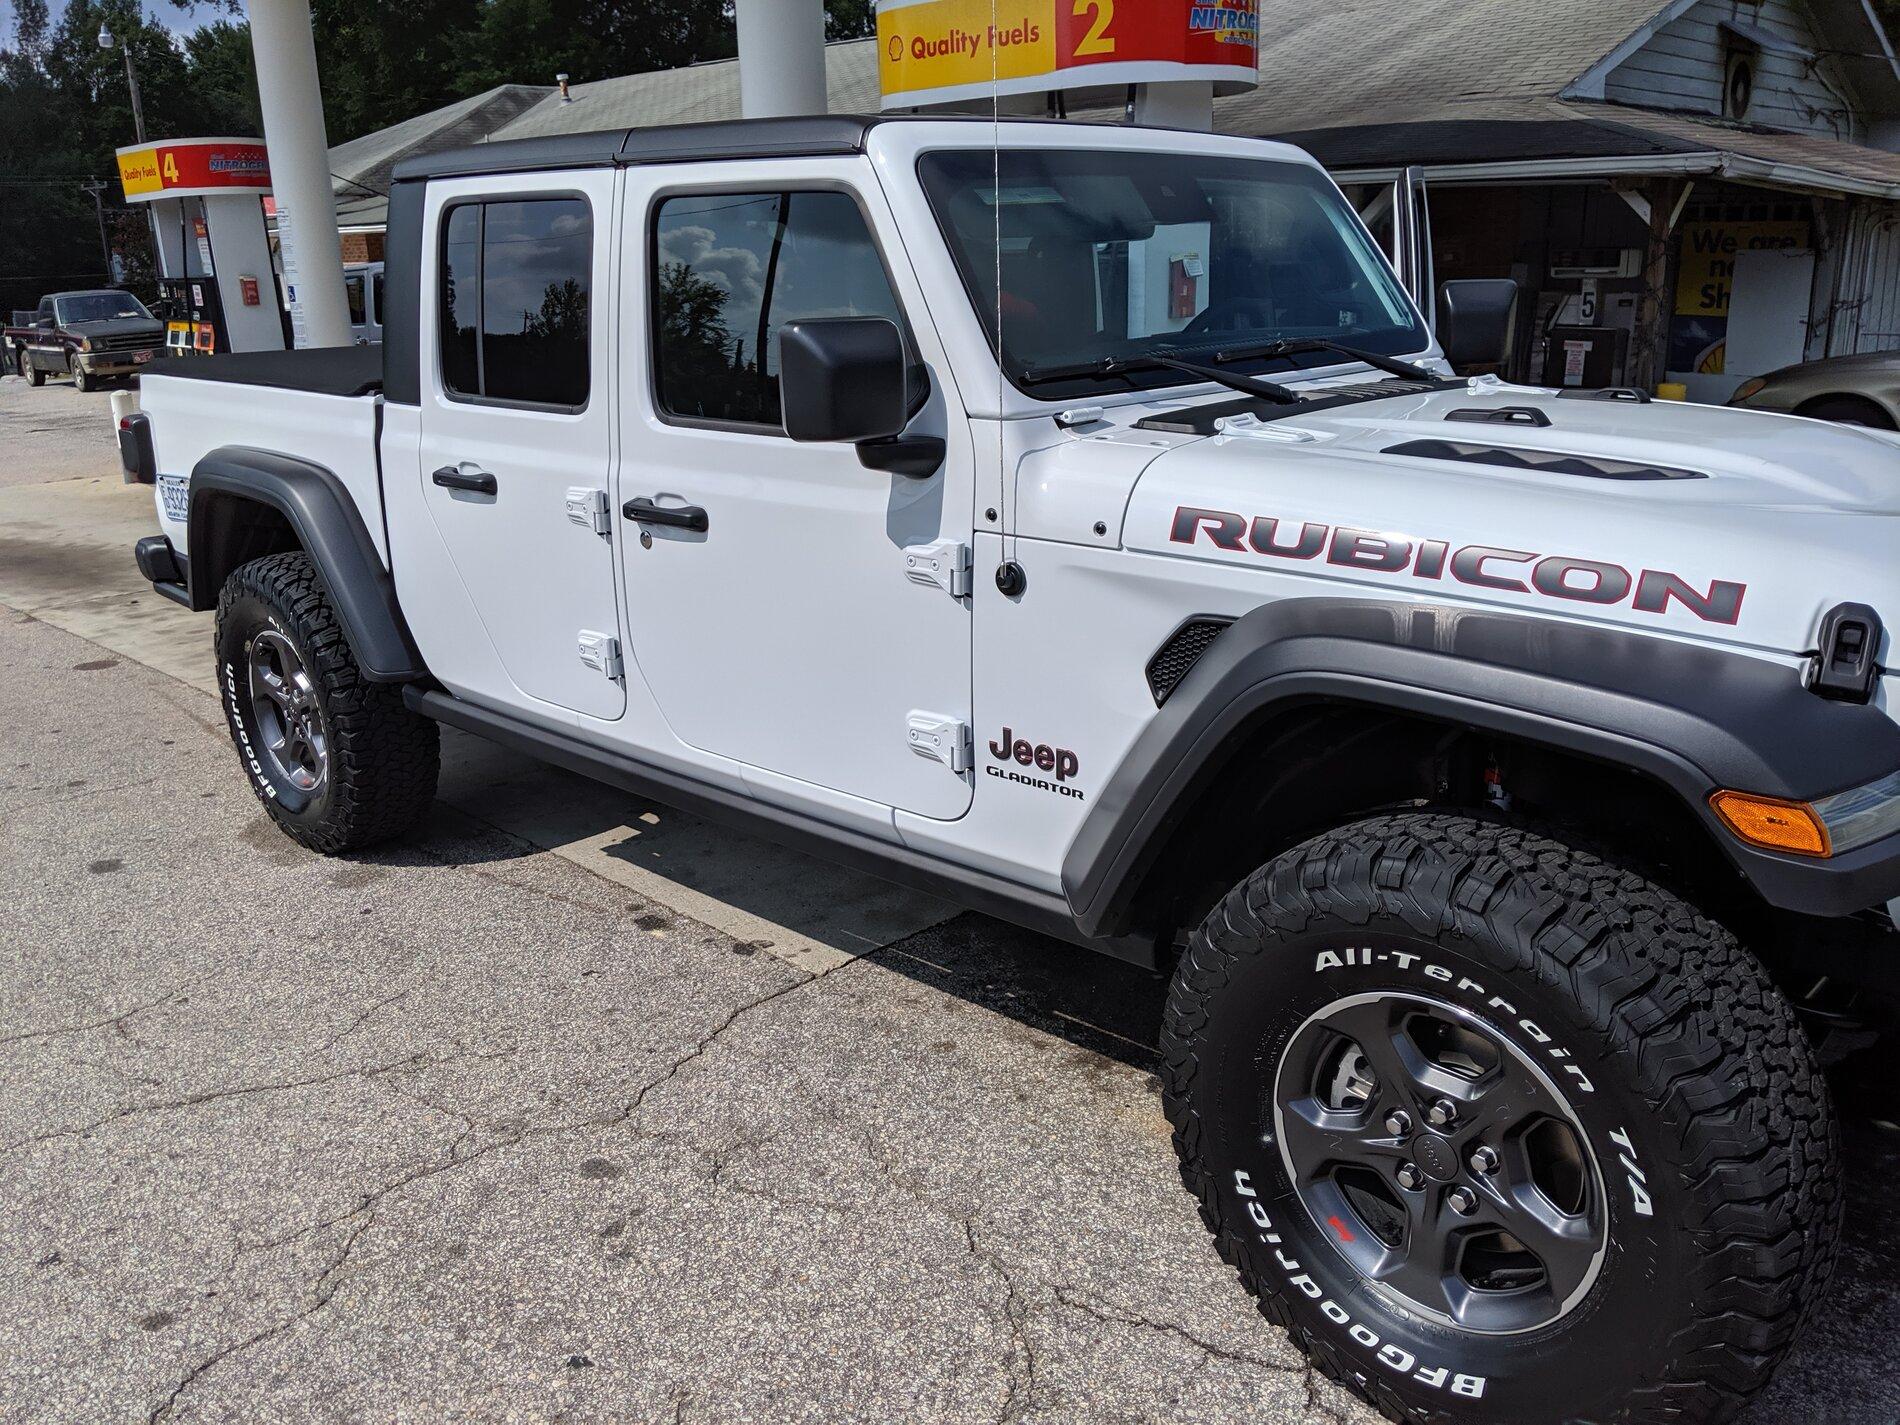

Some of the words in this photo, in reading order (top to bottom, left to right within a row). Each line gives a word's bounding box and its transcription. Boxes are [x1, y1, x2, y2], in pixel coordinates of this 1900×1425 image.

[911, 30, 981, 59] Quality
[988, 18, 1040, 48] Fuels
[1073, 0, 1115, 57] 2
[123, 168, 142, 181] Quality
[142, 164, 157, 178] Fuels
[163, 152, 180, 183] 4
[1692, 228, 1737, 254] We
[1581, 291, 1595, 318] 5
[1169, 506, 1747, 626] RUBICON
[226, 662, 277, 799] BFGoodrich
[988, 726, 1079, 782] Jeep
[986, 765, 1085, 801] GLADIATOR
[1315, 948, 1595, 1092] All-Terrain
[1608, 1126, 1654, 1216] T/A
[1234, 1169, 1487, 1399] BFGoodrich
